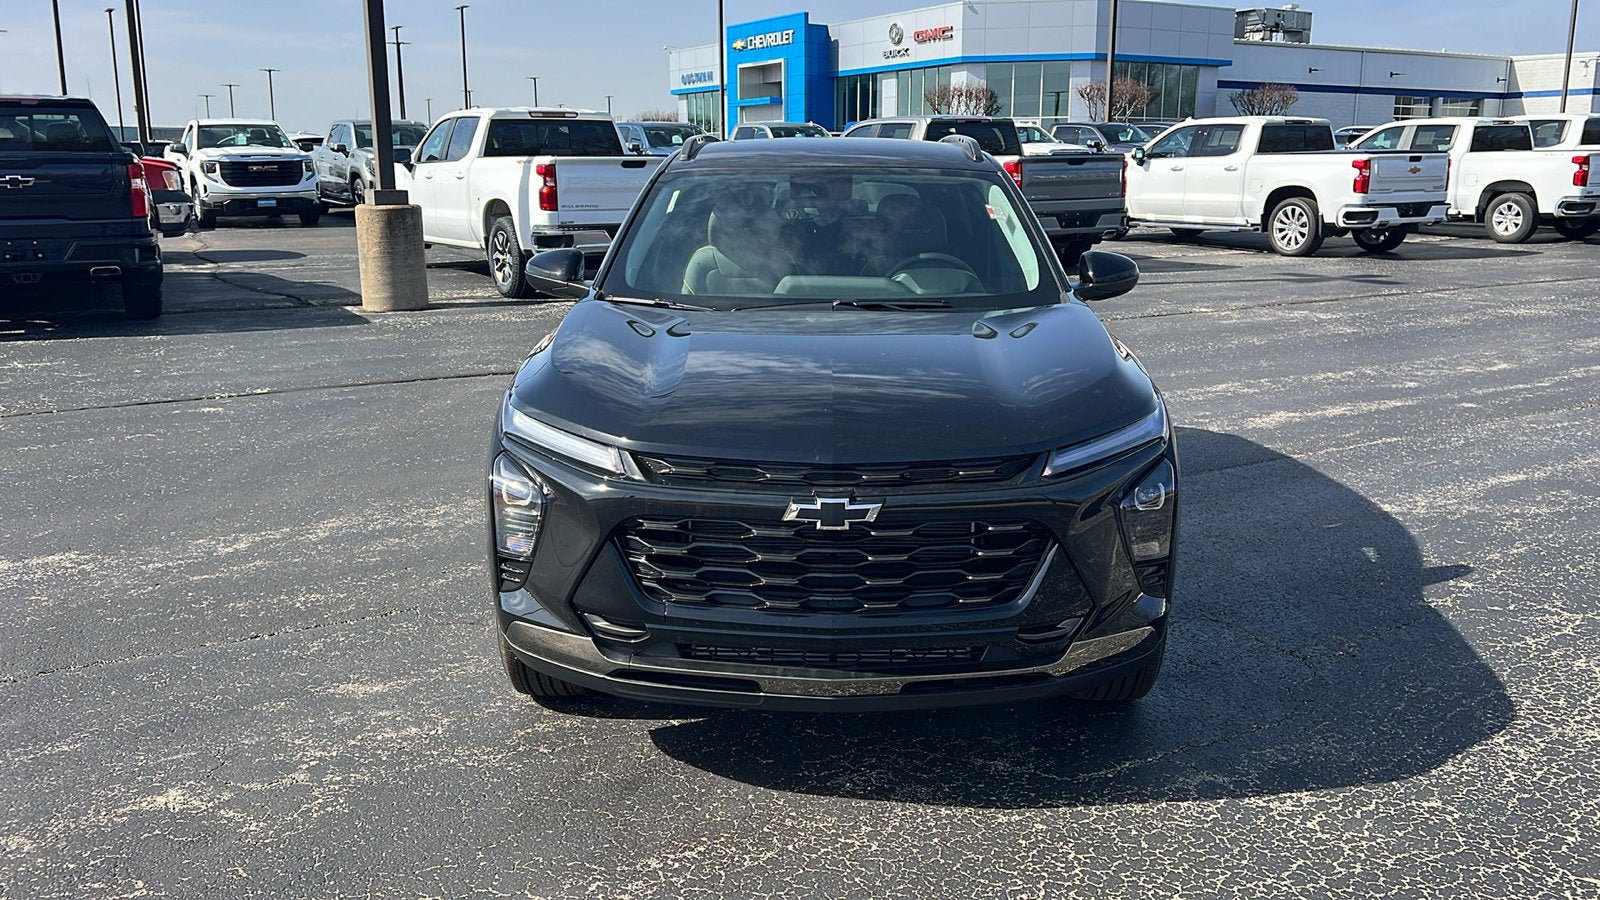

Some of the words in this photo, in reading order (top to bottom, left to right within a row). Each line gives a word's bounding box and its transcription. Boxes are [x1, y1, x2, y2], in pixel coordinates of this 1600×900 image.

[747, 29, 795, 50] CHEVROLET
[913, 26, 953, 43] GMC
[883, 48, 910, 60] BUICK
